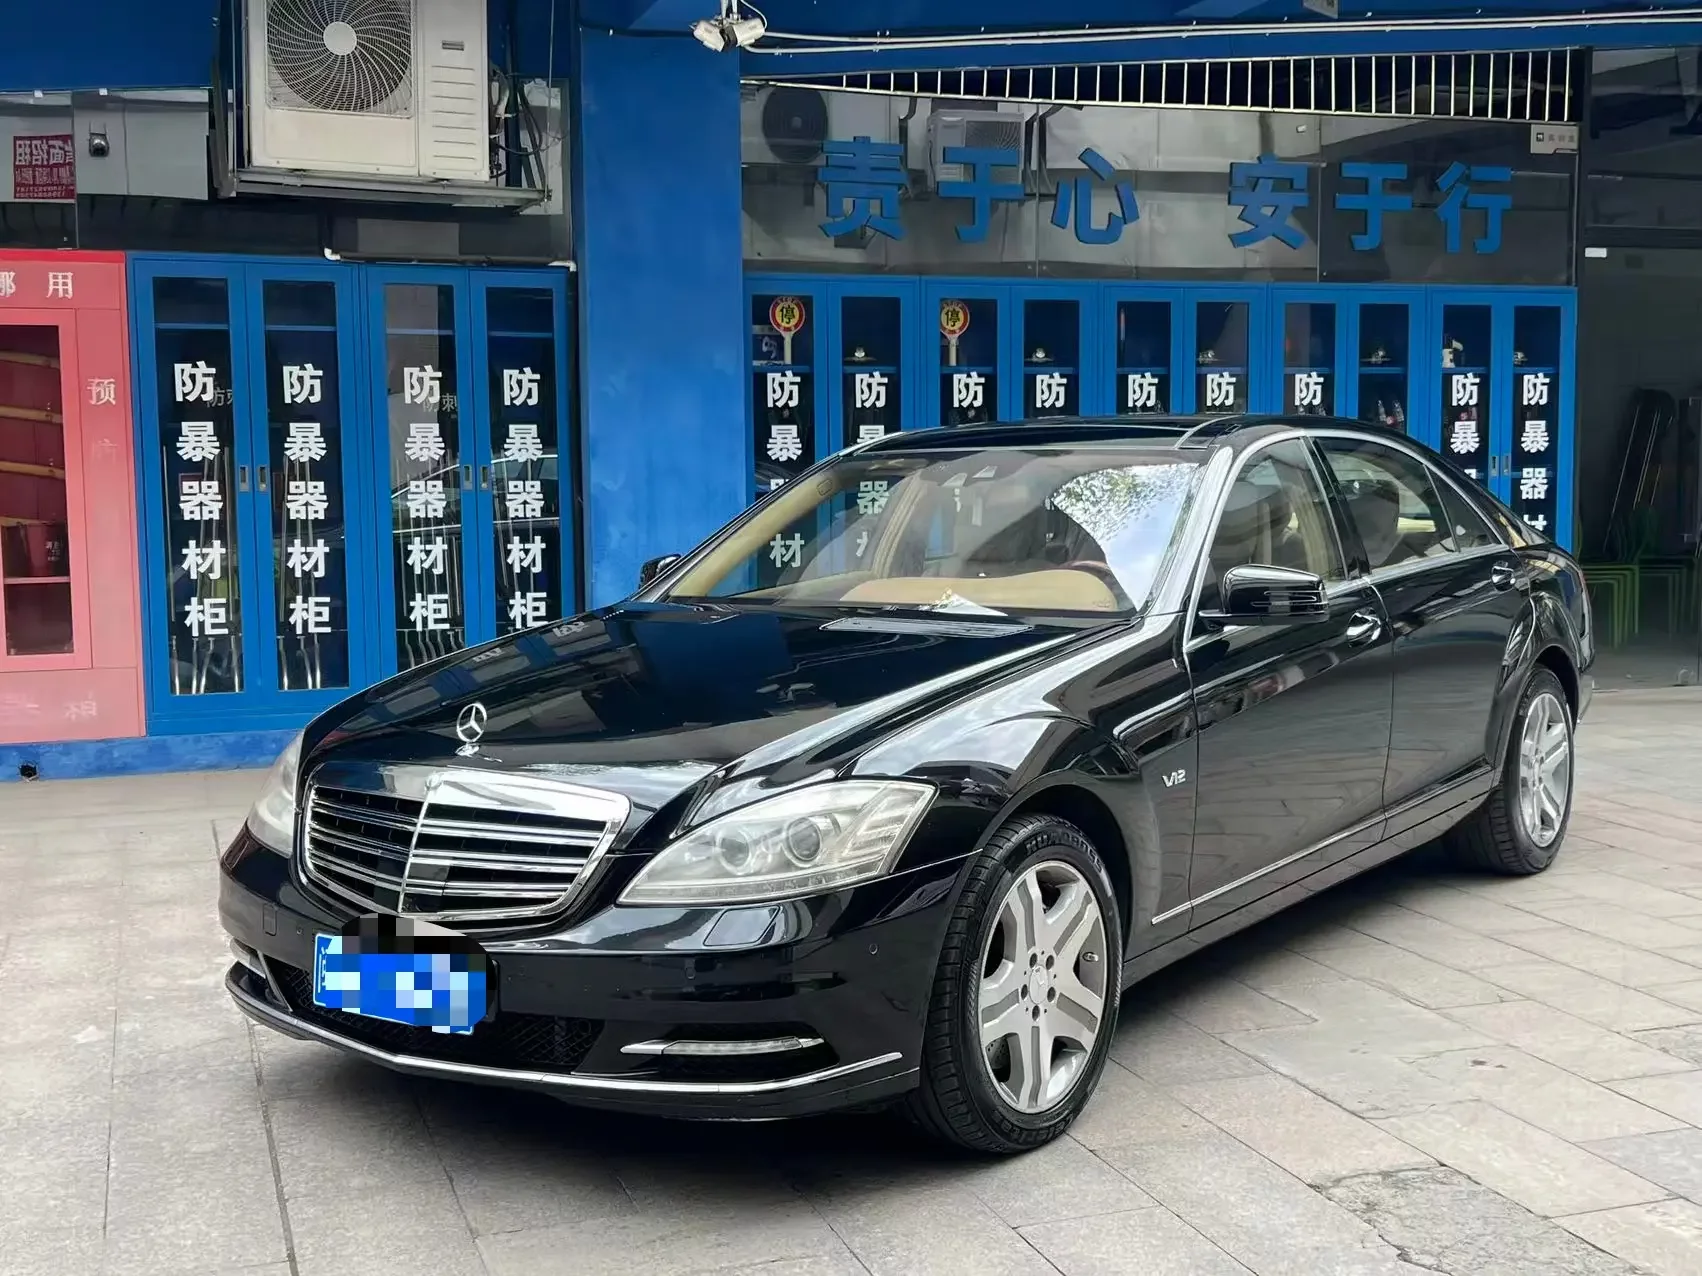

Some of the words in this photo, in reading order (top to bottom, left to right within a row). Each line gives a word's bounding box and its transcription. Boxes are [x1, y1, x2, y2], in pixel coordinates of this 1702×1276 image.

[817, 135, 1140, 245] 责于心
[1227, 154, 1513, 254] 安于行
[780, 304, 796, 325] 停
[944, 308, 961, 328] 停
[953, 372, 985, 408] 防
[1035, 372, 1067, 408] 防
[1127, 372, 1158, 407] 防
[1206, 372, 1236, 407] 防
[1294, 372, 1324, 406] 防
[174, 361, 229, 637] 防暴器材柜
[282, 363, 332, 635] 防暴器材柜
[403, 365, 450, 632] 防暴器材柜
[502, 367, 549, 630] 防暴器材柜
[1161, 769, 1186, 788] V12
